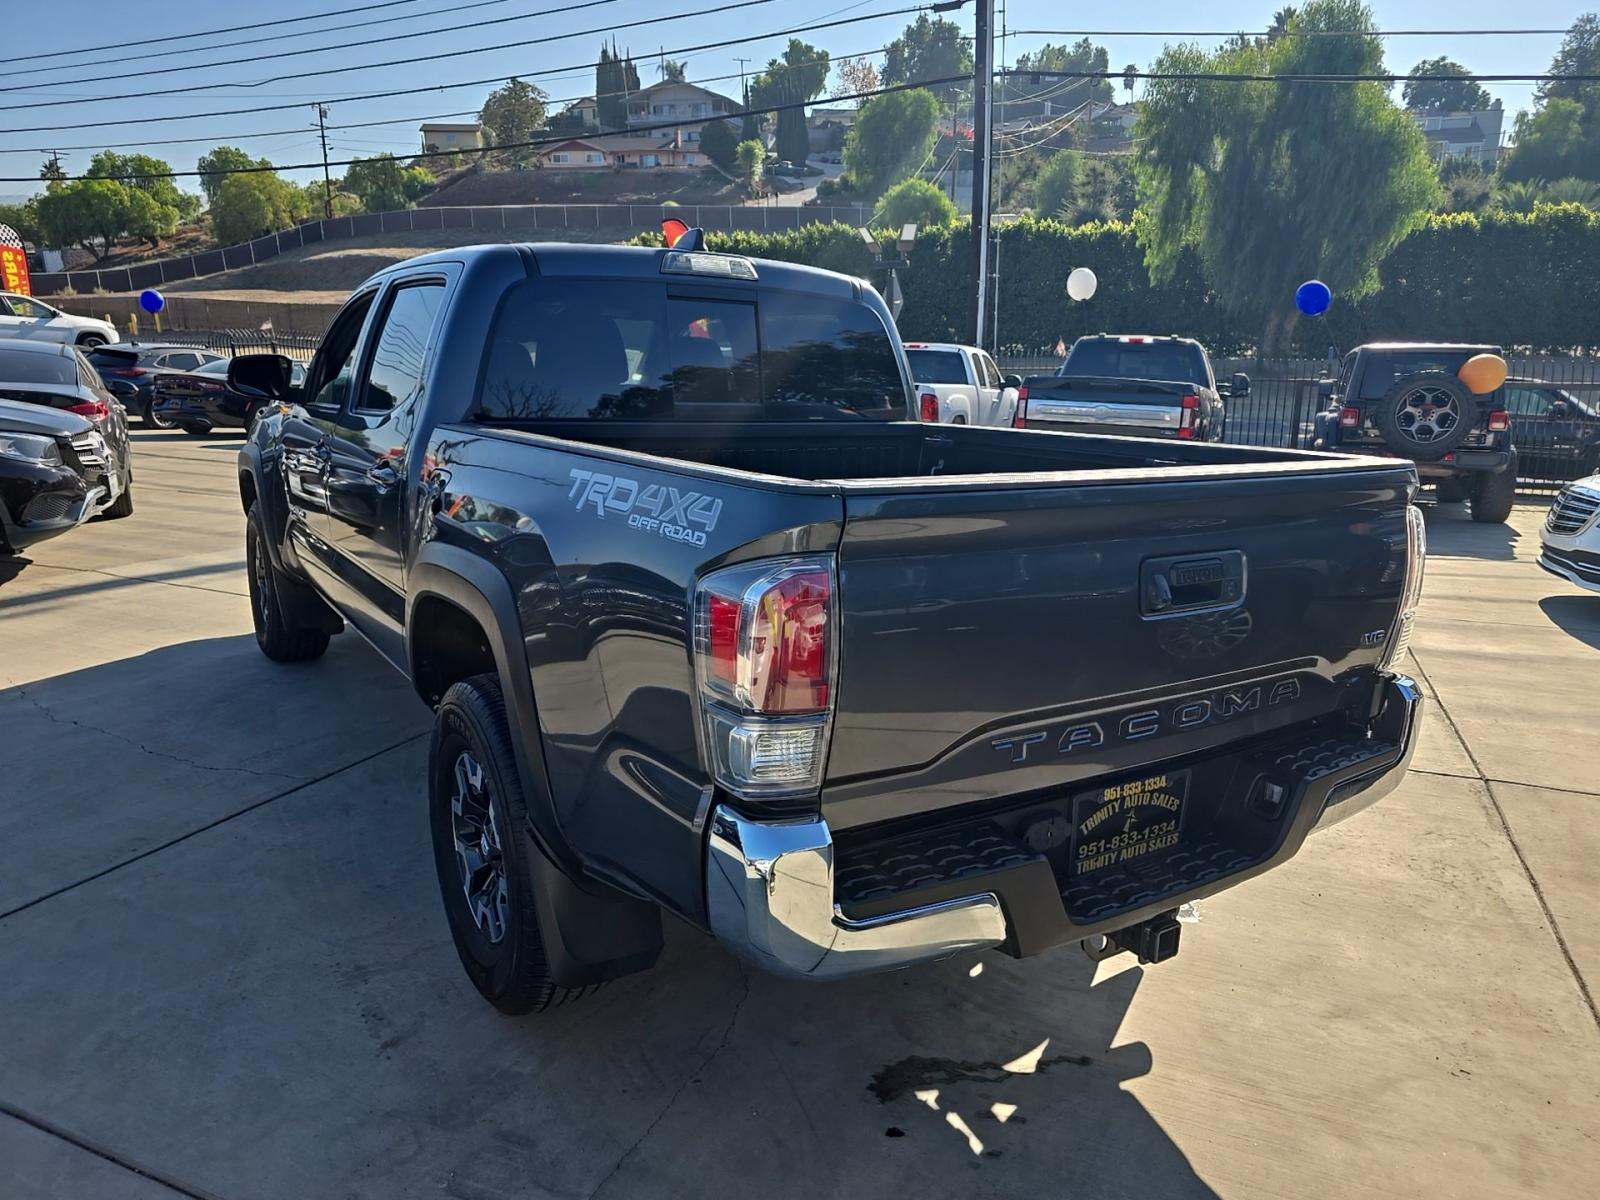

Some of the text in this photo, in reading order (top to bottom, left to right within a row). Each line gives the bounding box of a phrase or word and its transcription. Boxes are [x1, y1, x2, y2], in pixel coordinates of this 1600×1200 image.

[568, 468, 639, 517] TRD
[627, 513, 707, 547] OFF ROAD
[991, 678, 1301, 763] TACOMA
[1103, 775, 1168, 801] 951-833-1334
[1079, 792, 1180, 835] TRINITY AUTO SALES
[1079, 820, 1176, 858] 951-833-1334
[1119, 843, 1147, 861] AUTO
[1148, 832, 1180, 852] SALES
